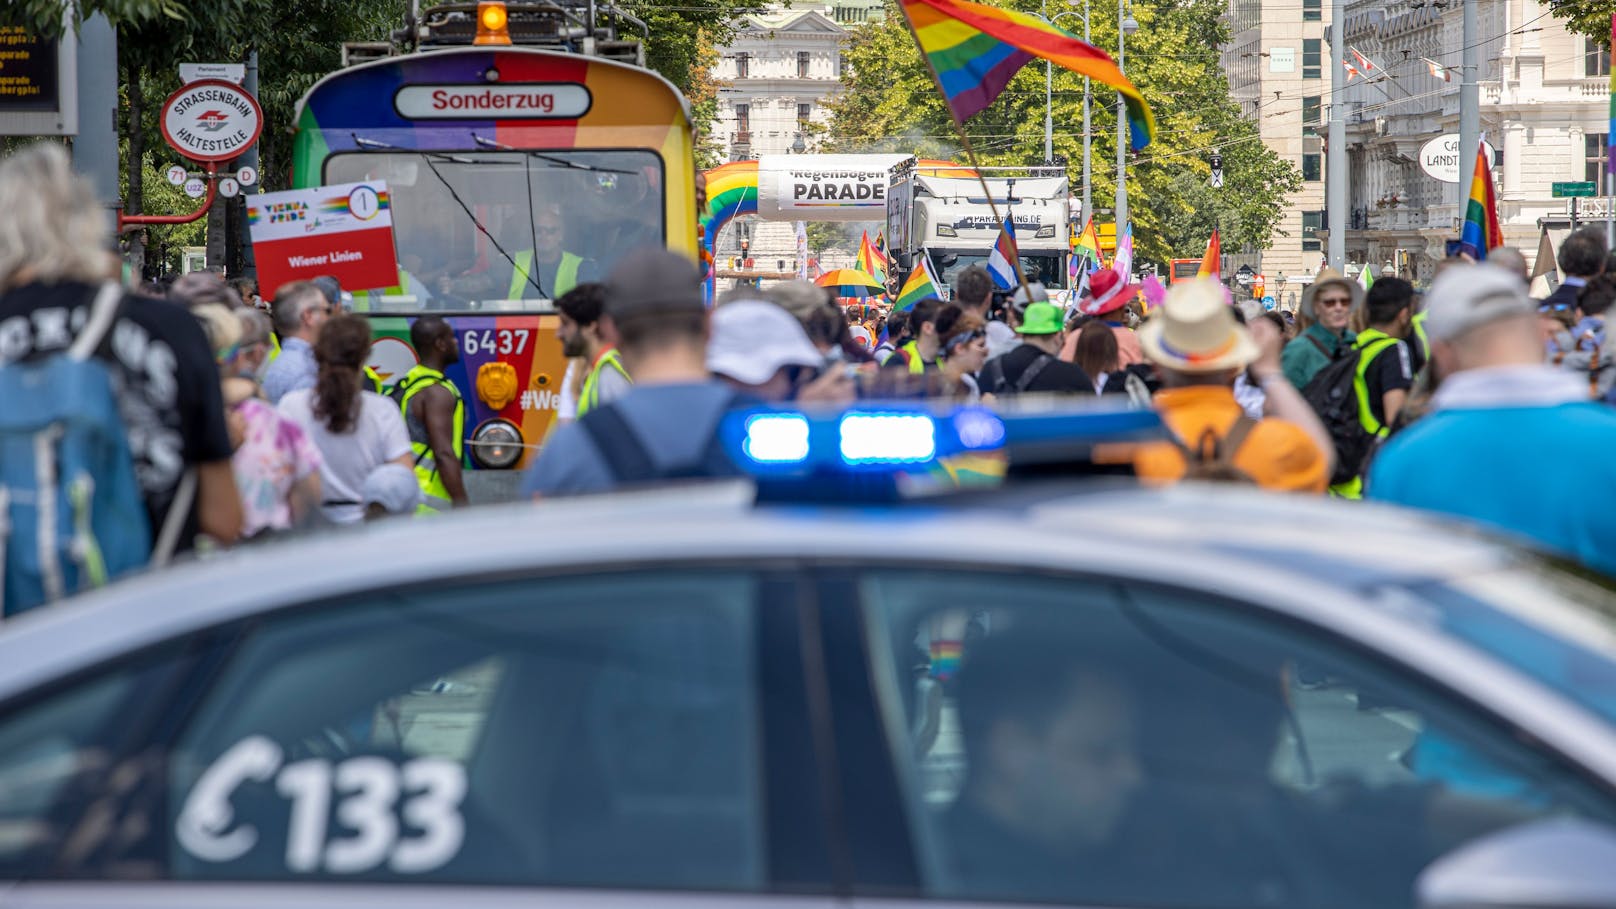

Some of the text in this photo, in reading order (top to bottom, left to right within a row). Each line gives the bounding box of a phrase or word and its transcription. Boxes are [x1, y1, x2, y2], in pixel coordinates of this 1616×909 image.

[174, 90, 252, 117] STRASSENBAHN
[432, 90, 554, 112] Sonderzug
[176, 127, 247, 151] HALTESTELLE
[1444, 141, 1460, 152] CA
[1427, 155, 1459, 166] LANDT
[171, 170, 184, 181] 71
[242, 171, 251, 181] D
[794, 183, 884, 200] PARADE
[270, 211, 305, 224] PRIDE
[288, 250, 362, 268] Wiener Linien
[464, 329, 529, 355] 6437
[275, 756, 468, 874] 133
